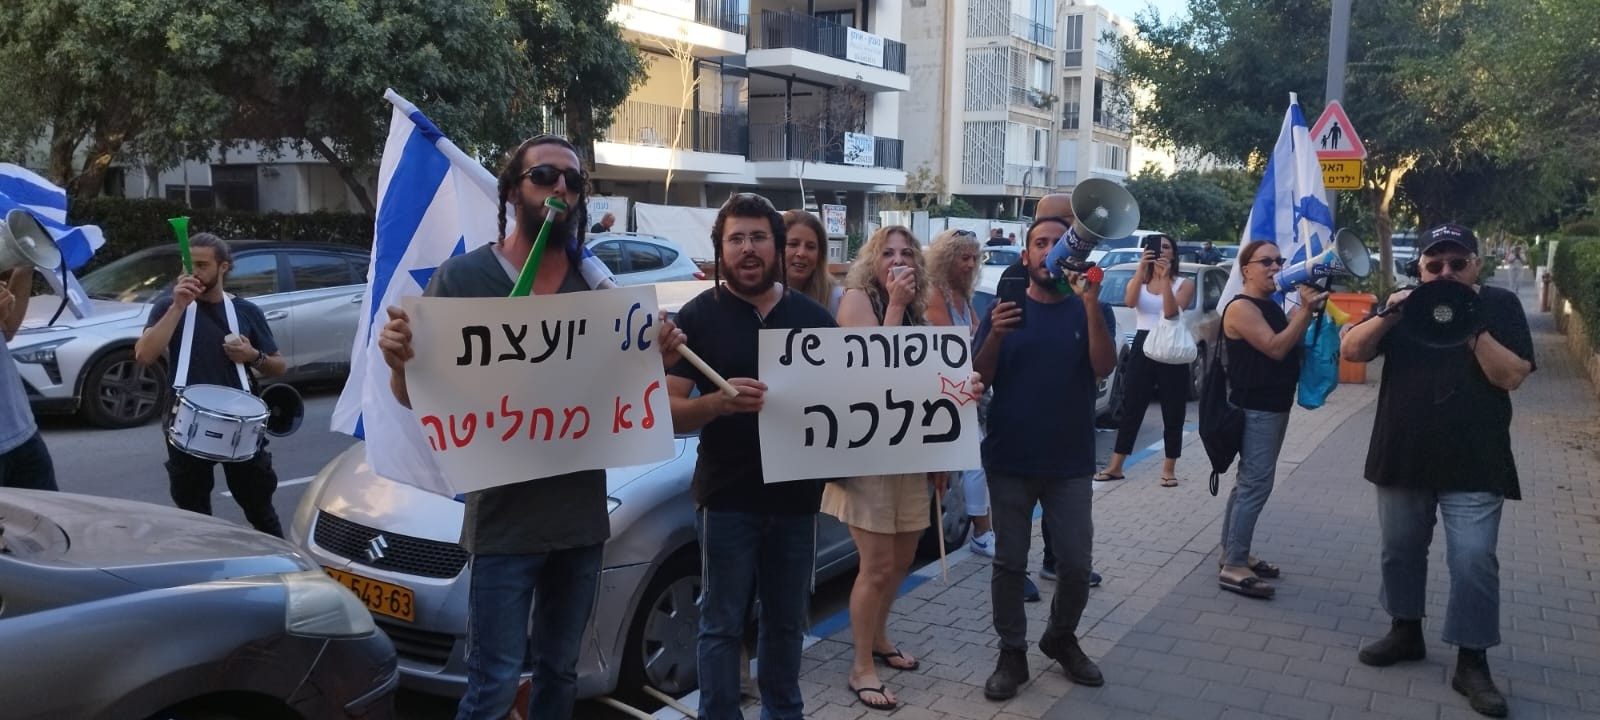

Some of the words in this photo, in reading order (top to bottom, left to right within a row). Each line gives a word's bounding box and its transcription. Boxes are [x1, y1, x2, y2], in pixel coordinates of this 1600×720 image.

[1328, 175, 1356, 184] ילדים
[456, 318, 587, 367] יועצת
[614, 302, 653, 351] גלי
[779, 328, 826, 366] של
[844, 333, 968, 369] סיפורה
[421, 395, 590, 452] מחליטה
[612, 380, 660, 434] לא
[804, 388, 962, 449] מלכה
